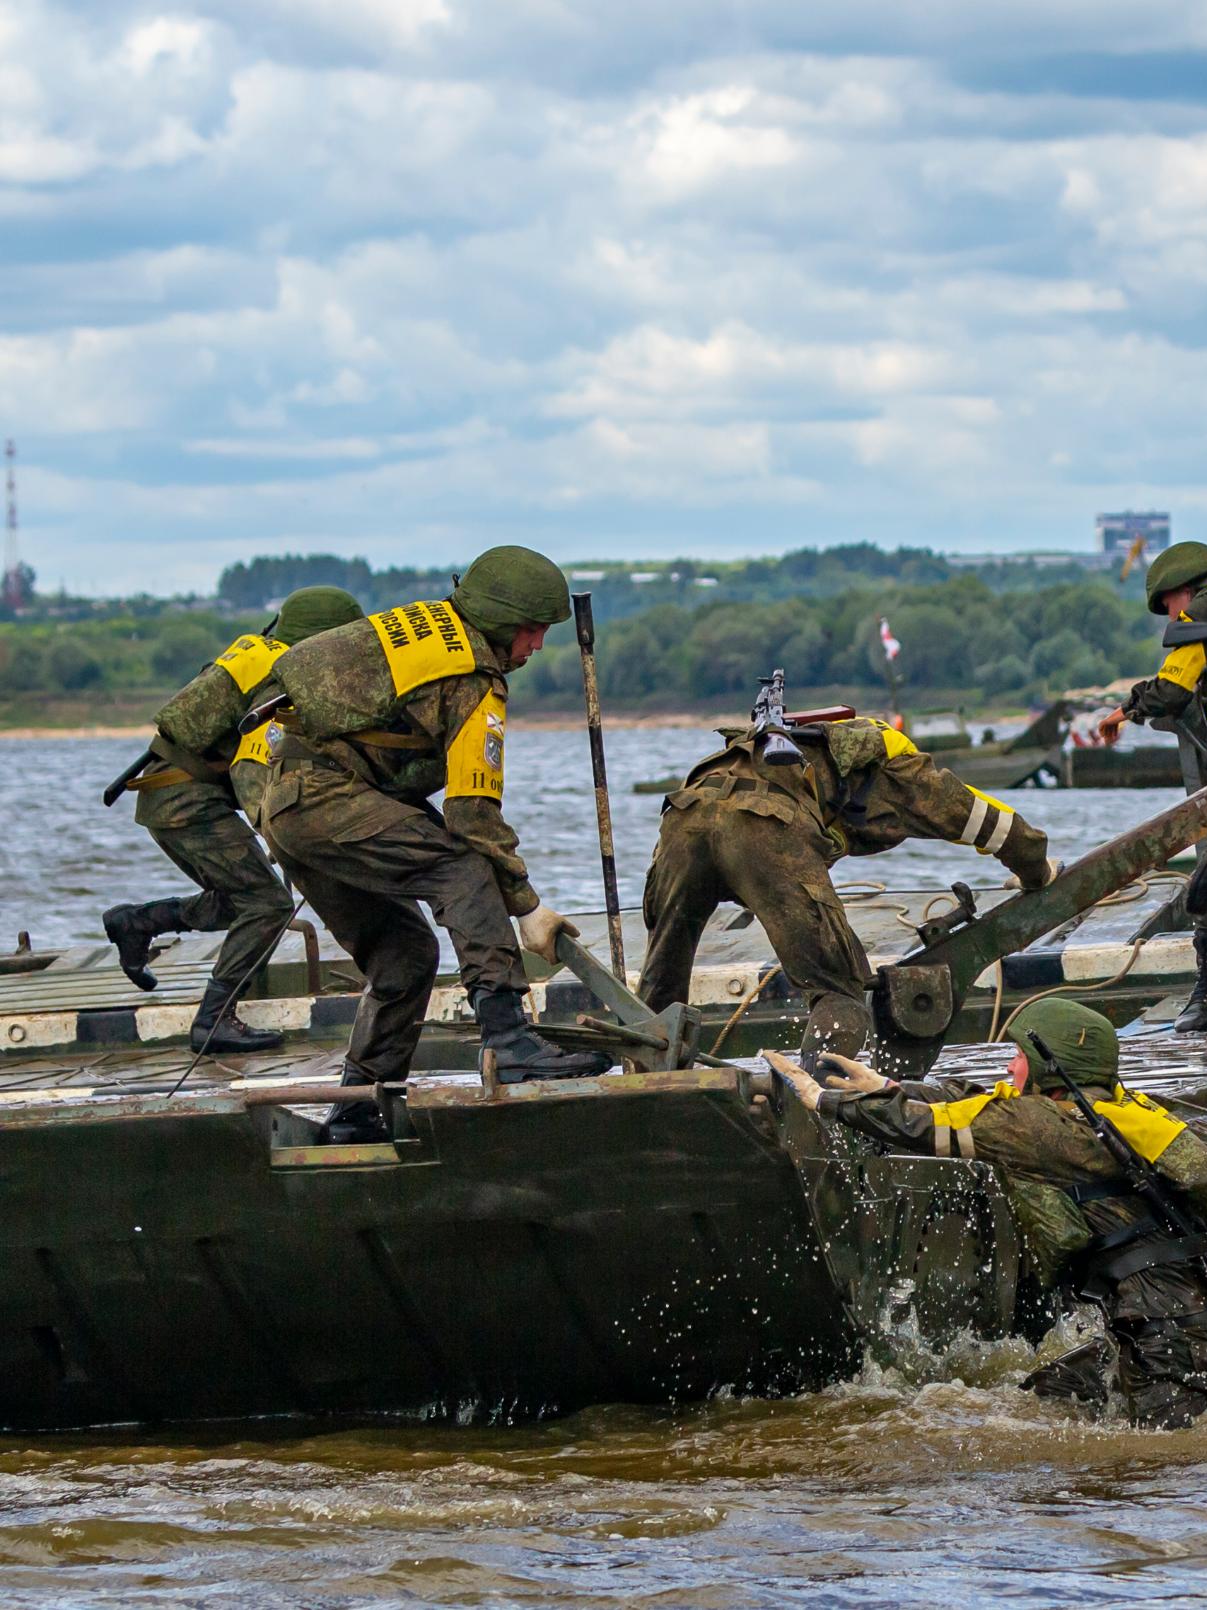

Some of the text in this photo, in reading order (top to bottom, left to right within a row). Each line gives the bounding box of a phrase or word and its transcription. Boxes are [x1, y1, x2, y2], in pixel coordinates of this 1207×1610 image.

[378, 611, 410, 649] ОССИИ
[402, 604, 433, 641] ОЙСКА
[424, 602, 464, 653] ЕНЕРНЫЕ
[472, 772, 485, 789] 11
